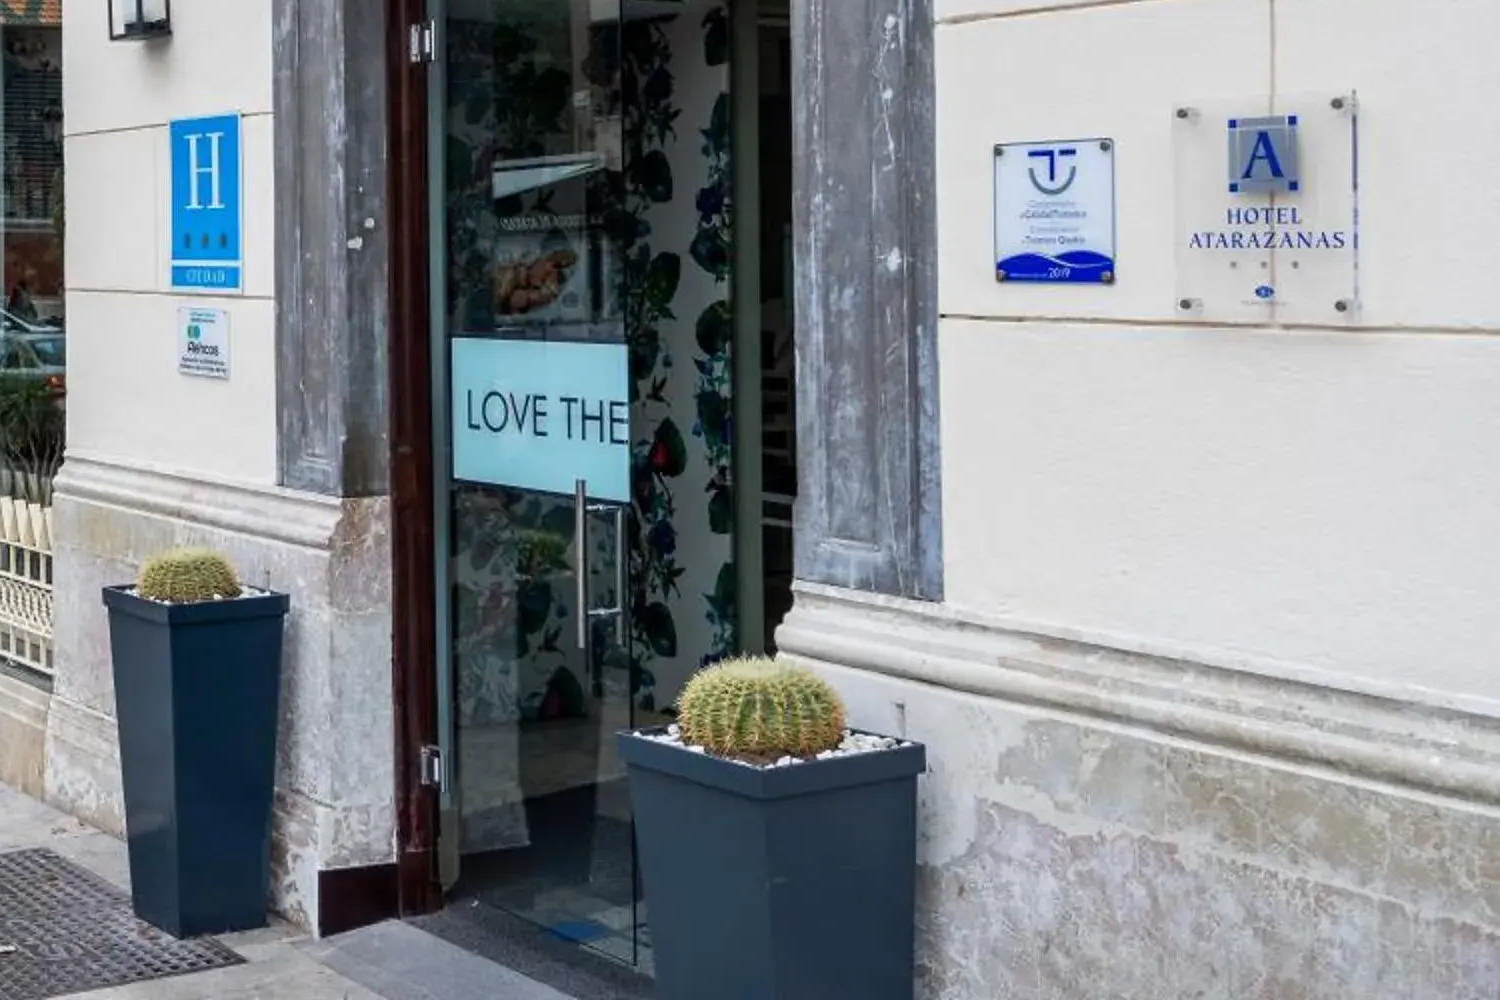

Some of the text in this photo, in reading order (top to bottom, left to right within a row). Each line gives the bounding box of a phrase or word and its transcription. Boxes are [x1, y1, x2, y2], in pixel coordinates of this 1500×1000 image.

[184, 131, 225, 209] H
[1241, 130, 1285, 180] A
[1189, 231, 1346, 250] ATARAZANAS
[1226, 207, 1302, 225] HOTEL
[467, 389, 630, 446] LOVE THE
